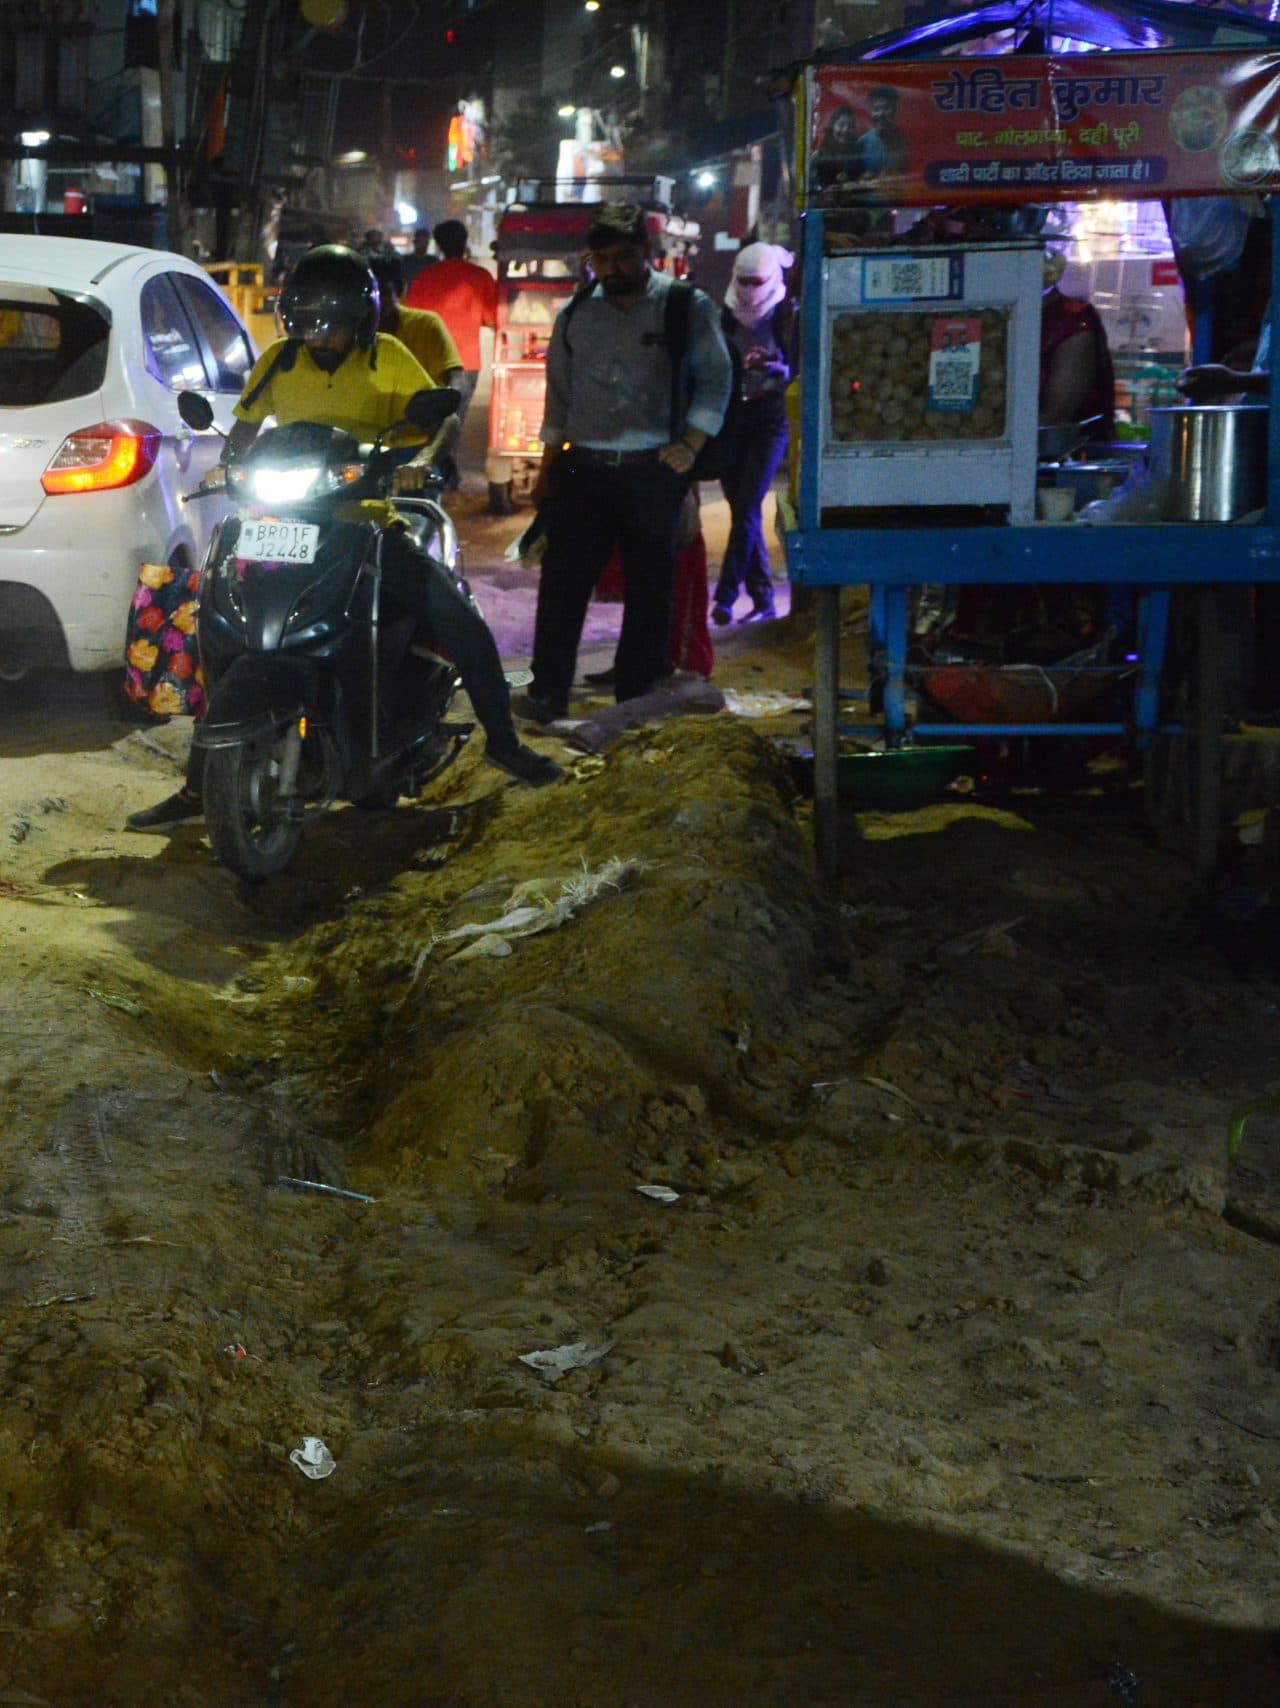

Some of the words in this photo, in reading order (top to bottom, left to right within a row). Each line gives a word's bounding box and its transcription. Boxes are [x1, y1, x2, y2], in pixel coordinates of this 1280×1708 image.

[931, 67, 1043, 114] रोहित
[1051, 74, 1169, 121] कुमार
[1001, 167, 1021, 181] का
[1061, 160, 1094, 180] लिया
[1095, 164, 1131, 180] जाता
